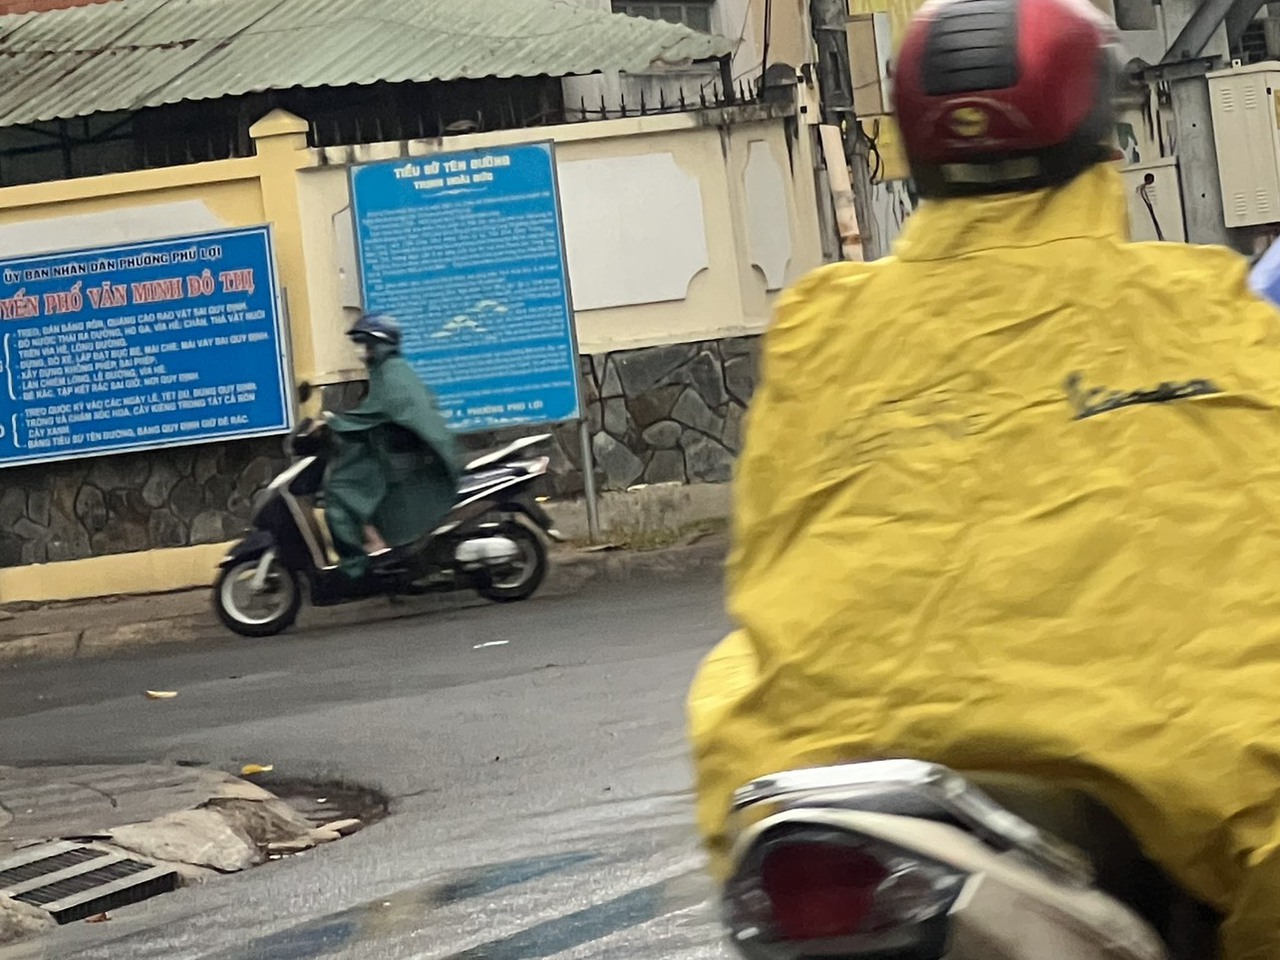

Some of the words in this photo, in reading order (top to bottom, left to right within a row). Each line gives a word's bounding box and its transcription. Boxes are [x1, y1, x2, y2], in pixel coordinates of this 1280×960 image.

[24, 267, 49, 280] BAN
[52, 261, 86, 277] NHÂN
[90, 258, 115, 272] DÂN
[200, 245, 221, 260] LỢI
[43, 280, 82, 314] PHỐ
[86, 281, 126, 309] VĂN
[131, 278, 181, 303] MINH
[186, 269, 214, 297] ĐÔ
[219, 268, 253, 296] THỊ
